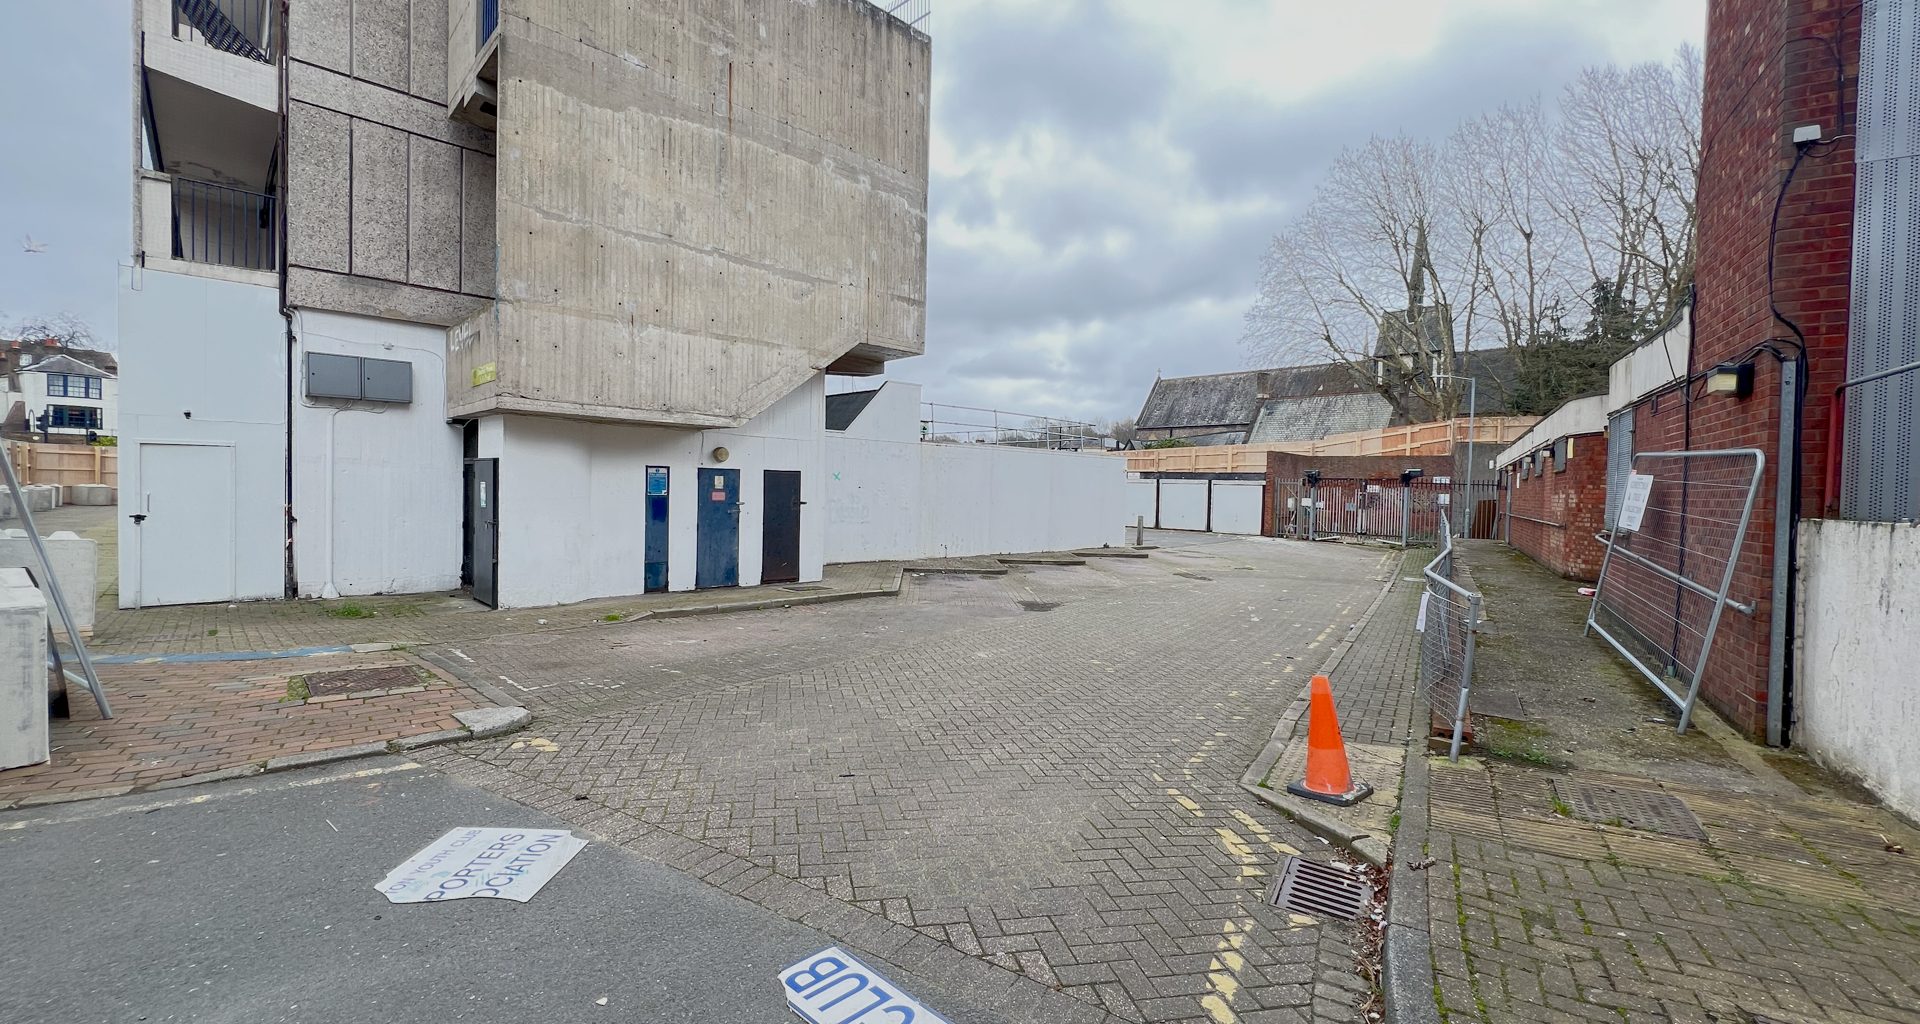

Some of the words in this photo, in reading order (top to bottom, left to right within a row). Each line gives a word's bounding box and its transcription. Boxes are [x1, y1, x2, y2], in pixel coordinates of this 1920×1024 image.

[409, 849, 456, 875] YOUTH
[450, 829, 482, 848] CLUB
[423, 833, 525, 901] PORTERS
